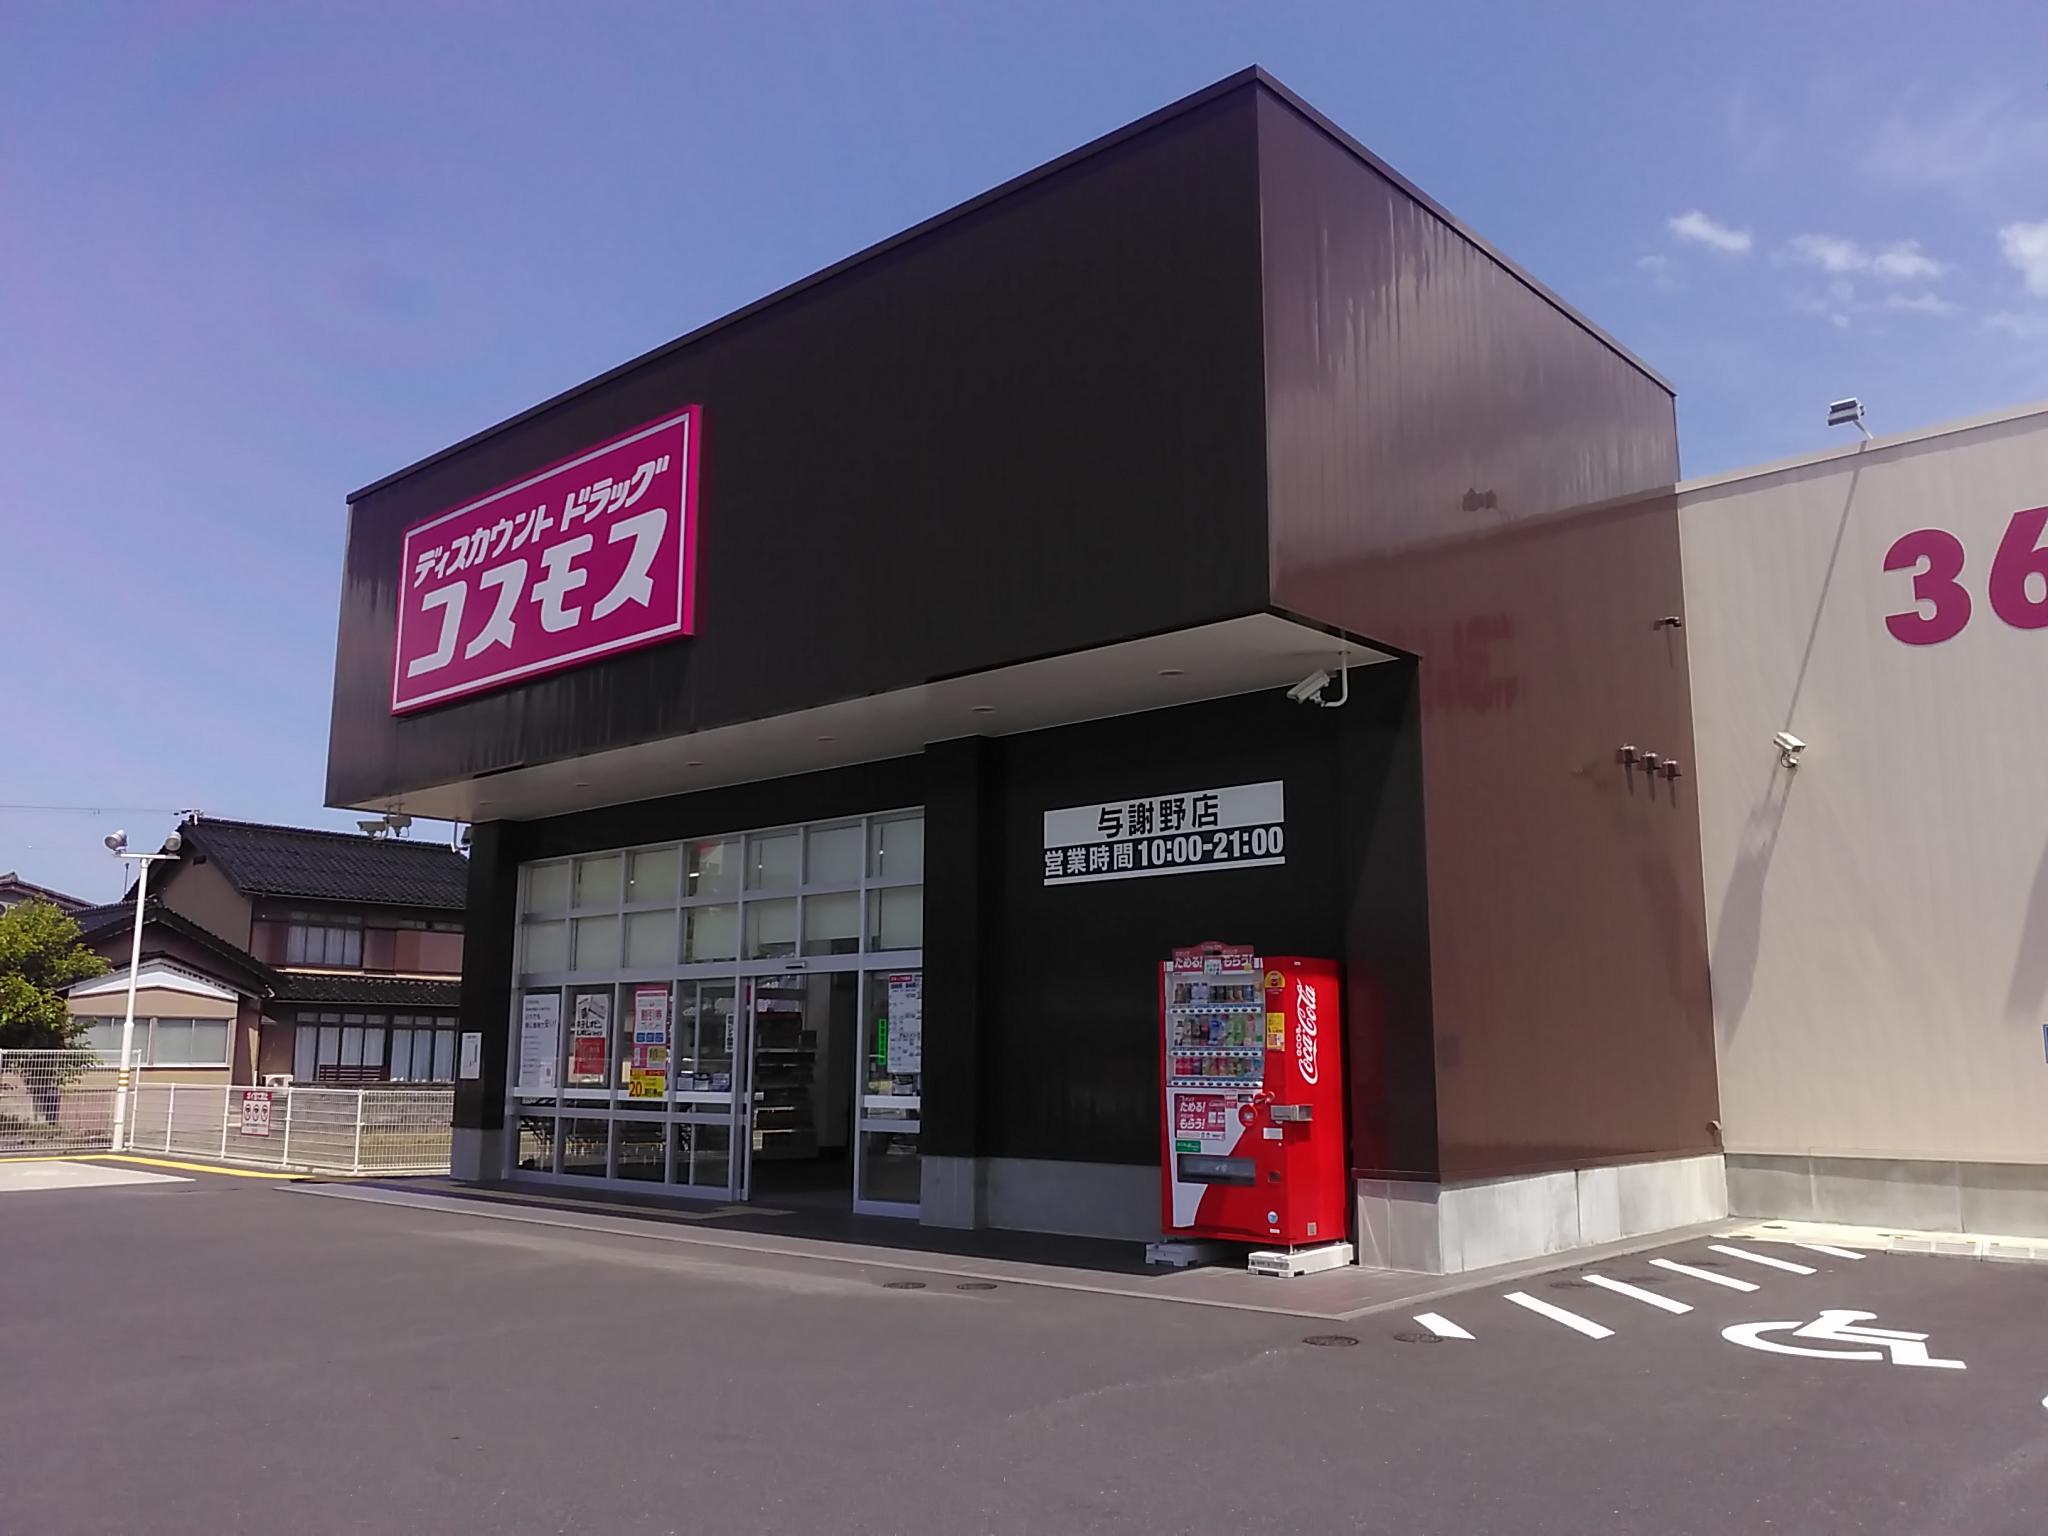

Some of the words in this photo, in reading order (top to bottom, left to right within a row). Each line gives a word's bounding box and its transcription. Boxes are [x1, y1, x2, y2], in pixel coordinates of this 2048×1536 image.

[414, 504, 553, 588] ディスカウント
[560, 455, 670, 532] ドラッグ
[1883, 505, 2048, 645] 36
[407, 508, 668, 679] コスモス
[1097, 794, 1219, 839] 与謝野店
[1297, 977, 1318, 1085] Coca-Cola
